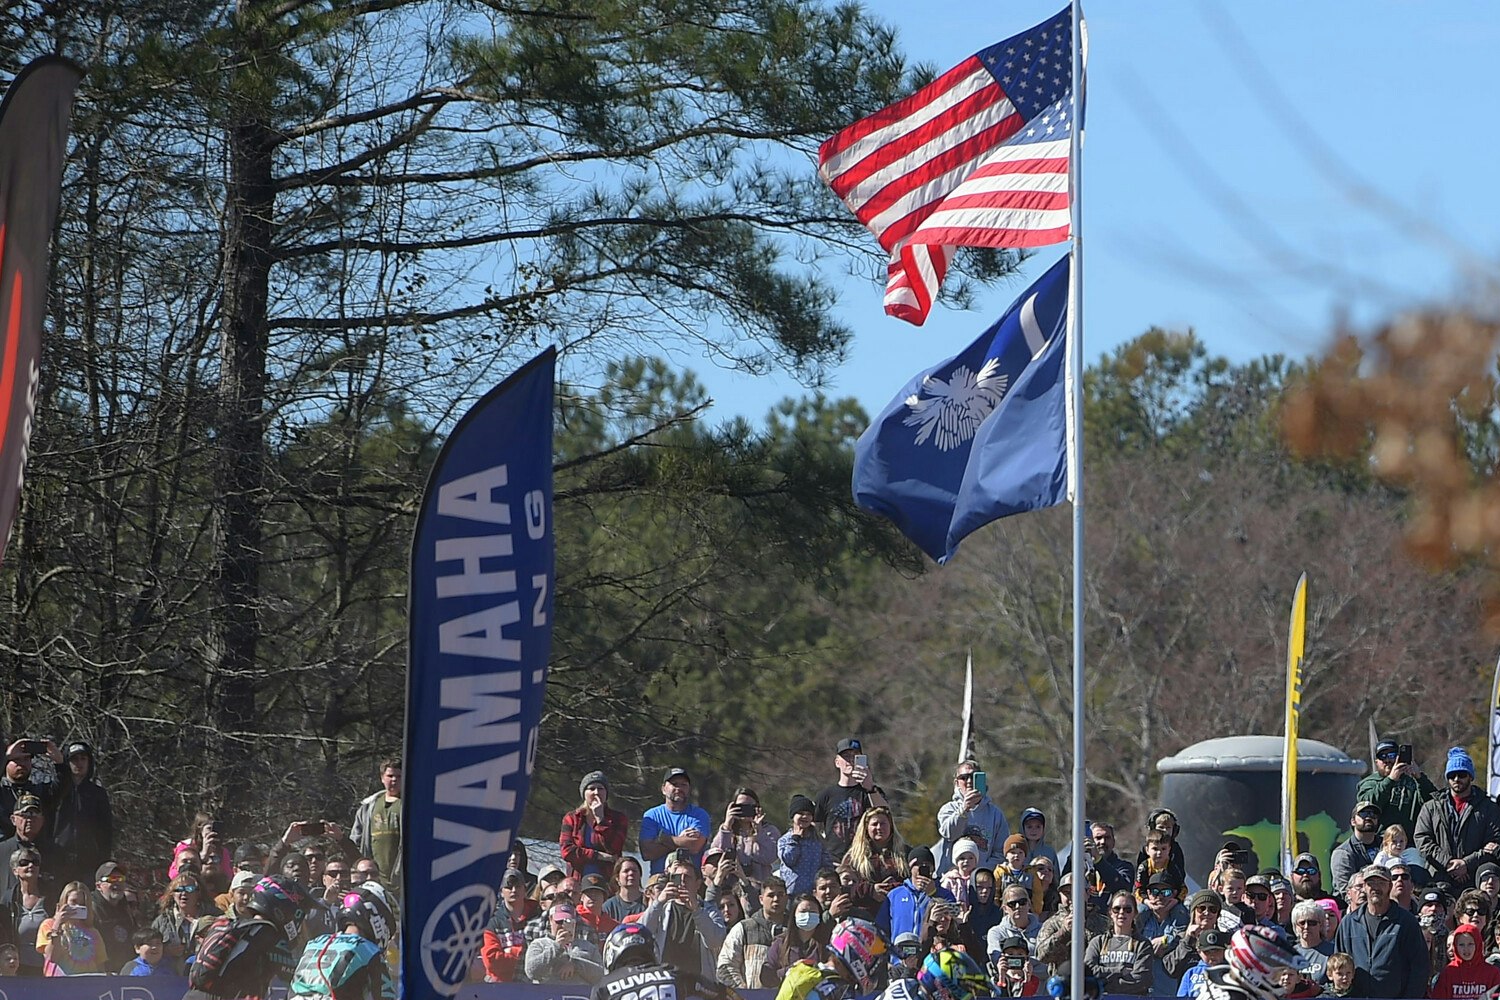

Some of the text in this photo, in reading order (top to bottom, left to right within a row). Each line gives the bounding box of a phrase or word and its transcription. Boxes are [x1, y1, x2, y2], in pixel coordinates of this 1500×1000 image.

[430, 464, 522, 881] YAMAHA
[607, 970, 674, 996] DUVALL
[1452, 985, 1487, 996] TRUMP
